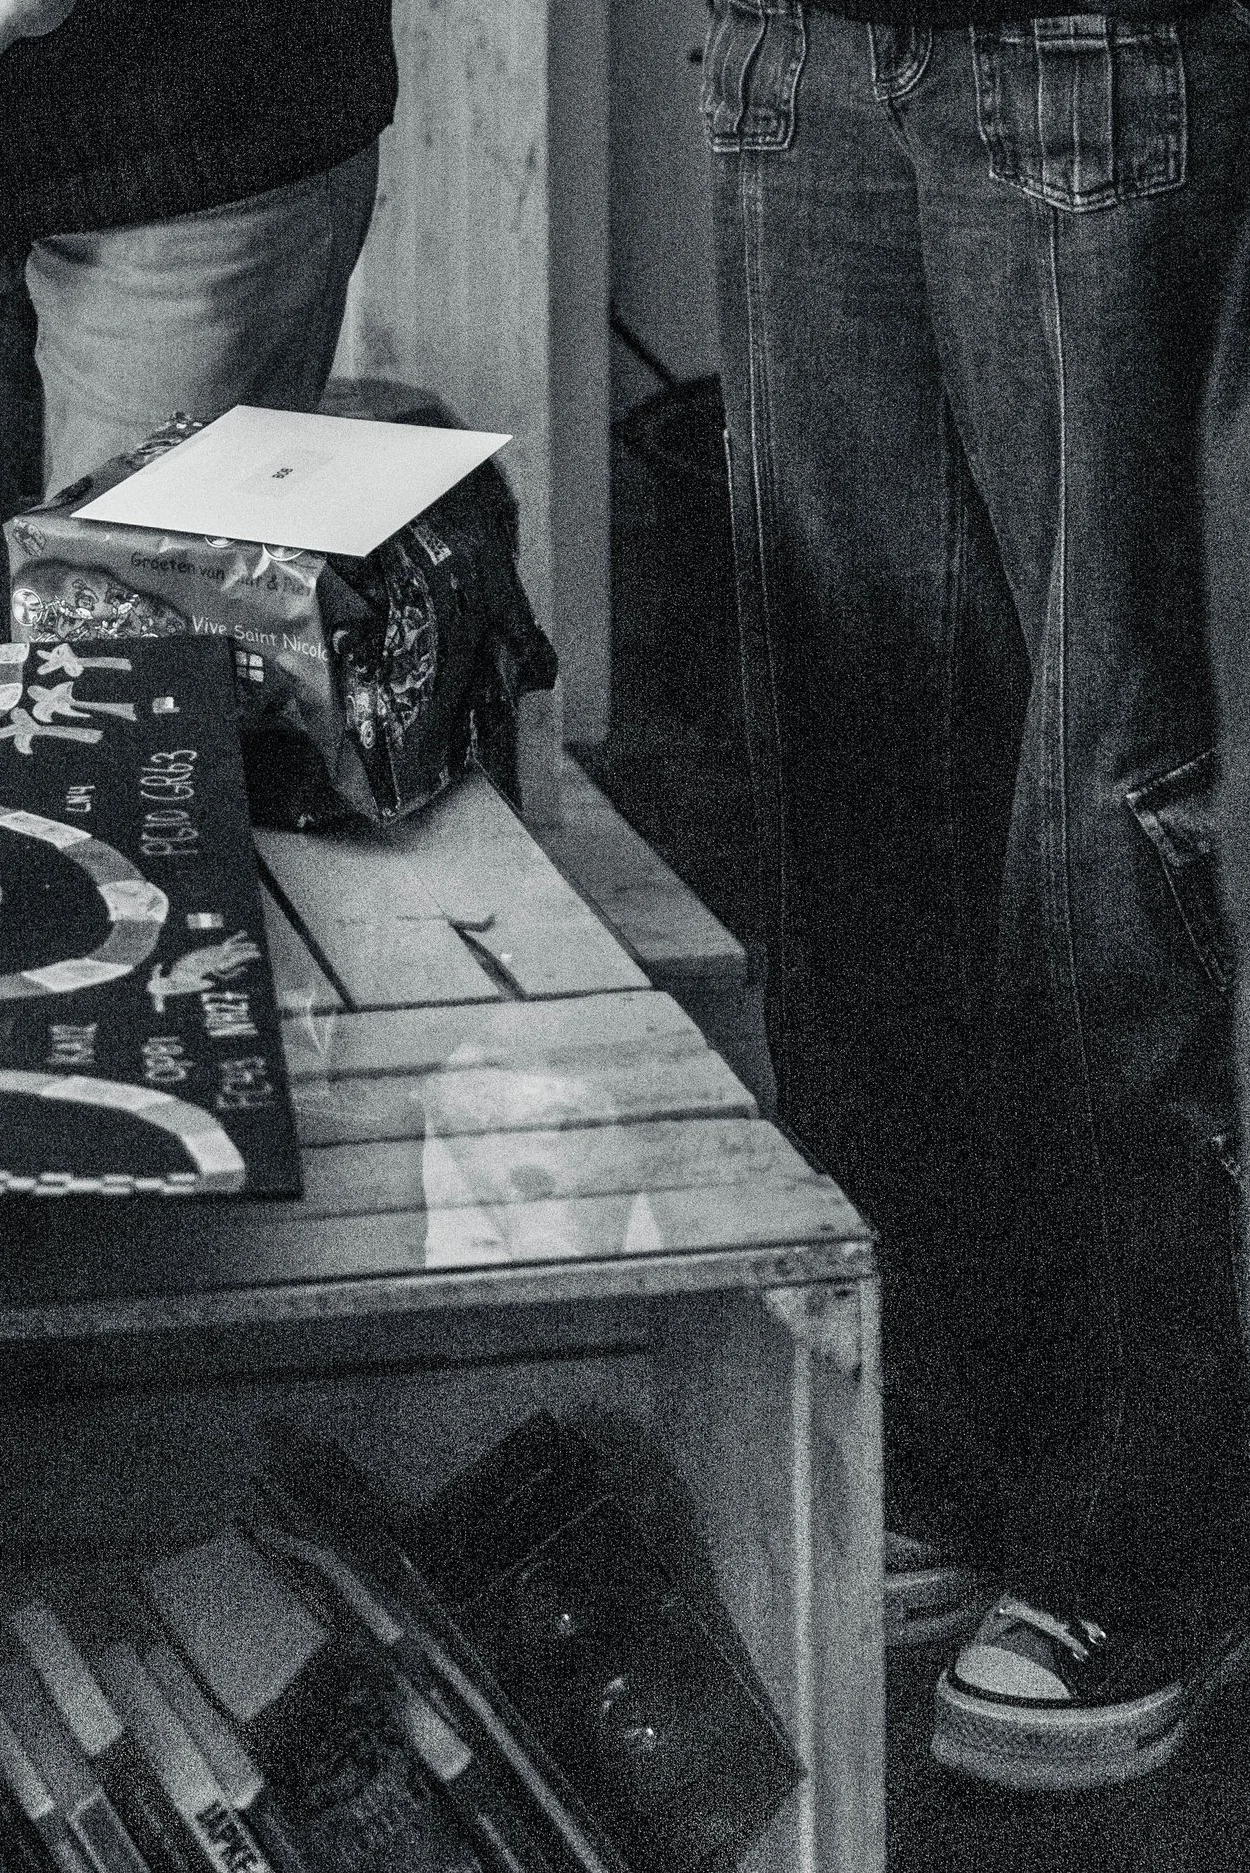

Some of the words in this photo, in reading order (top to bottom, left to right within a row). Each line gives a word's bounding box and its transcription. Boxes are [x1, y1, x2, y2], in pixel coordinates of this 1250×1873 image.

[271, 467, 294, 479] BOB
[131, 552, 196, 574] Groeten
[200, 565, 226, 580] van
[192, 615, 227, 635] Vive
[234, 625, 277, 646] Saint
